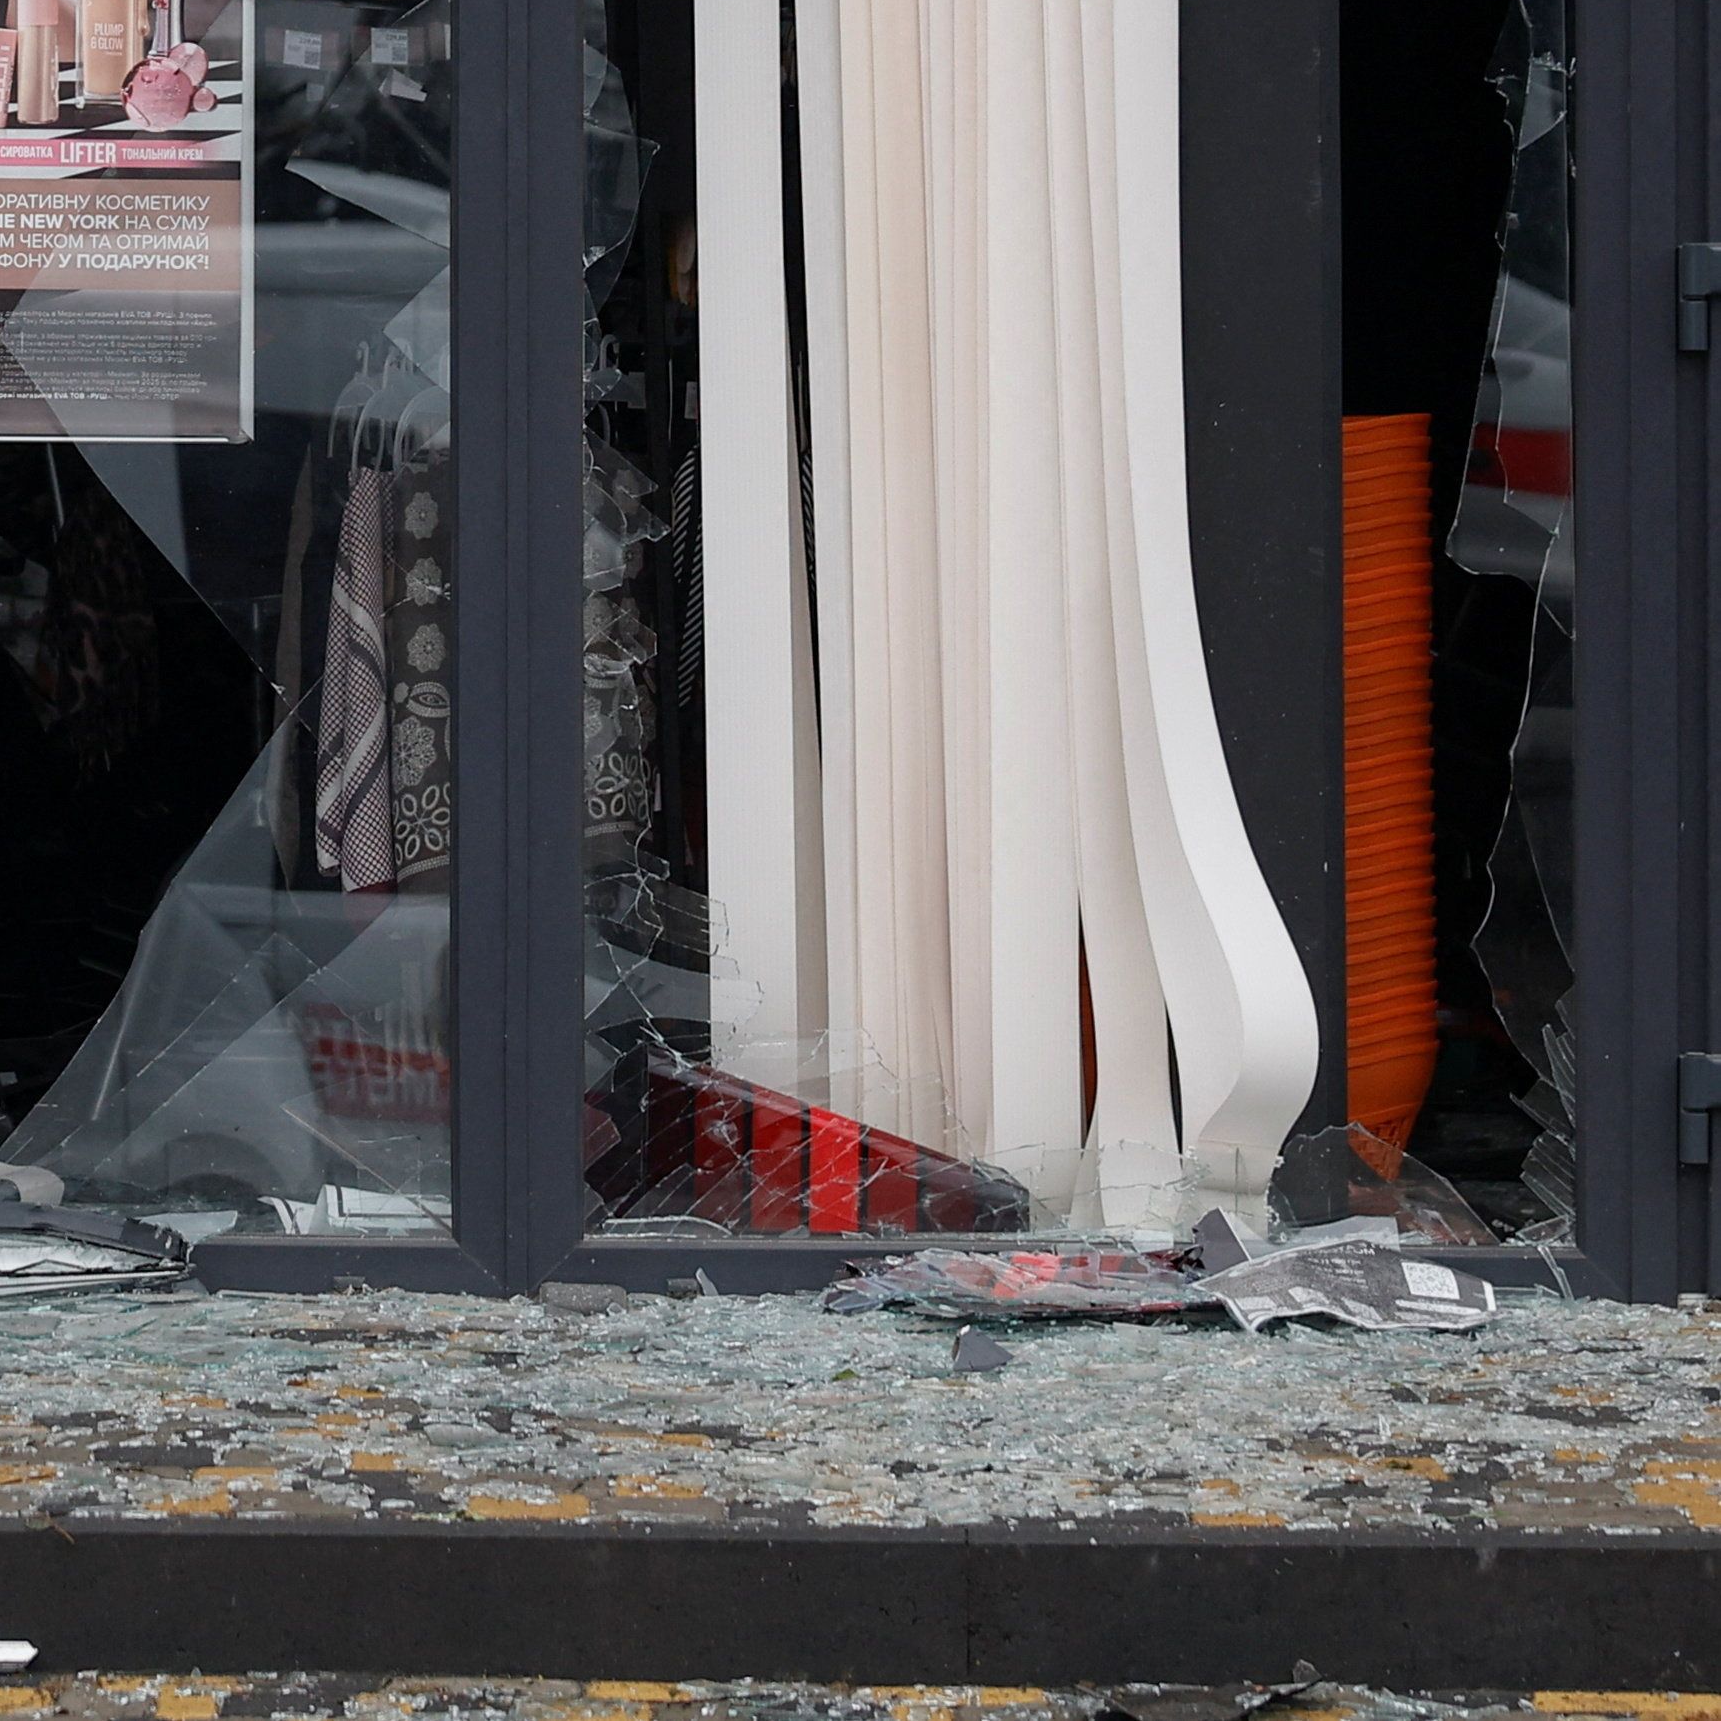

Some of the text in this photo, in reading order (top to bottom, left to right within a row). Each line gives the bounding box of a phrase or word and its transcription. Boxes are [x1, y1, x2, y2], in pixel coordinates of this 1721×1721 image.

[94, 23, 124, 36] PLUMP
[98, 37, 124, 51] GLOW
[60, 141, 117, 164] LIFTER
[122, 146, 176, 161] ТОНАЛЬНИЙ
[178, 148, 205, 160] КРЕМ
[95, 195, 210, 211] КОСМЕТИКУ
[20, 213, 64, 228] NEW
[68, 214, 120, 229] YORK
[125, 215, 150, 229] НА
[156, 215, 210, 230] СУМУ
[19, 233, 84, 249] ЧЕКОМ
[89, 234, 111, 249] ТА
[116, 232, 209, 250] ОТРИМАЙ
[58, 253, 72, 269] У
